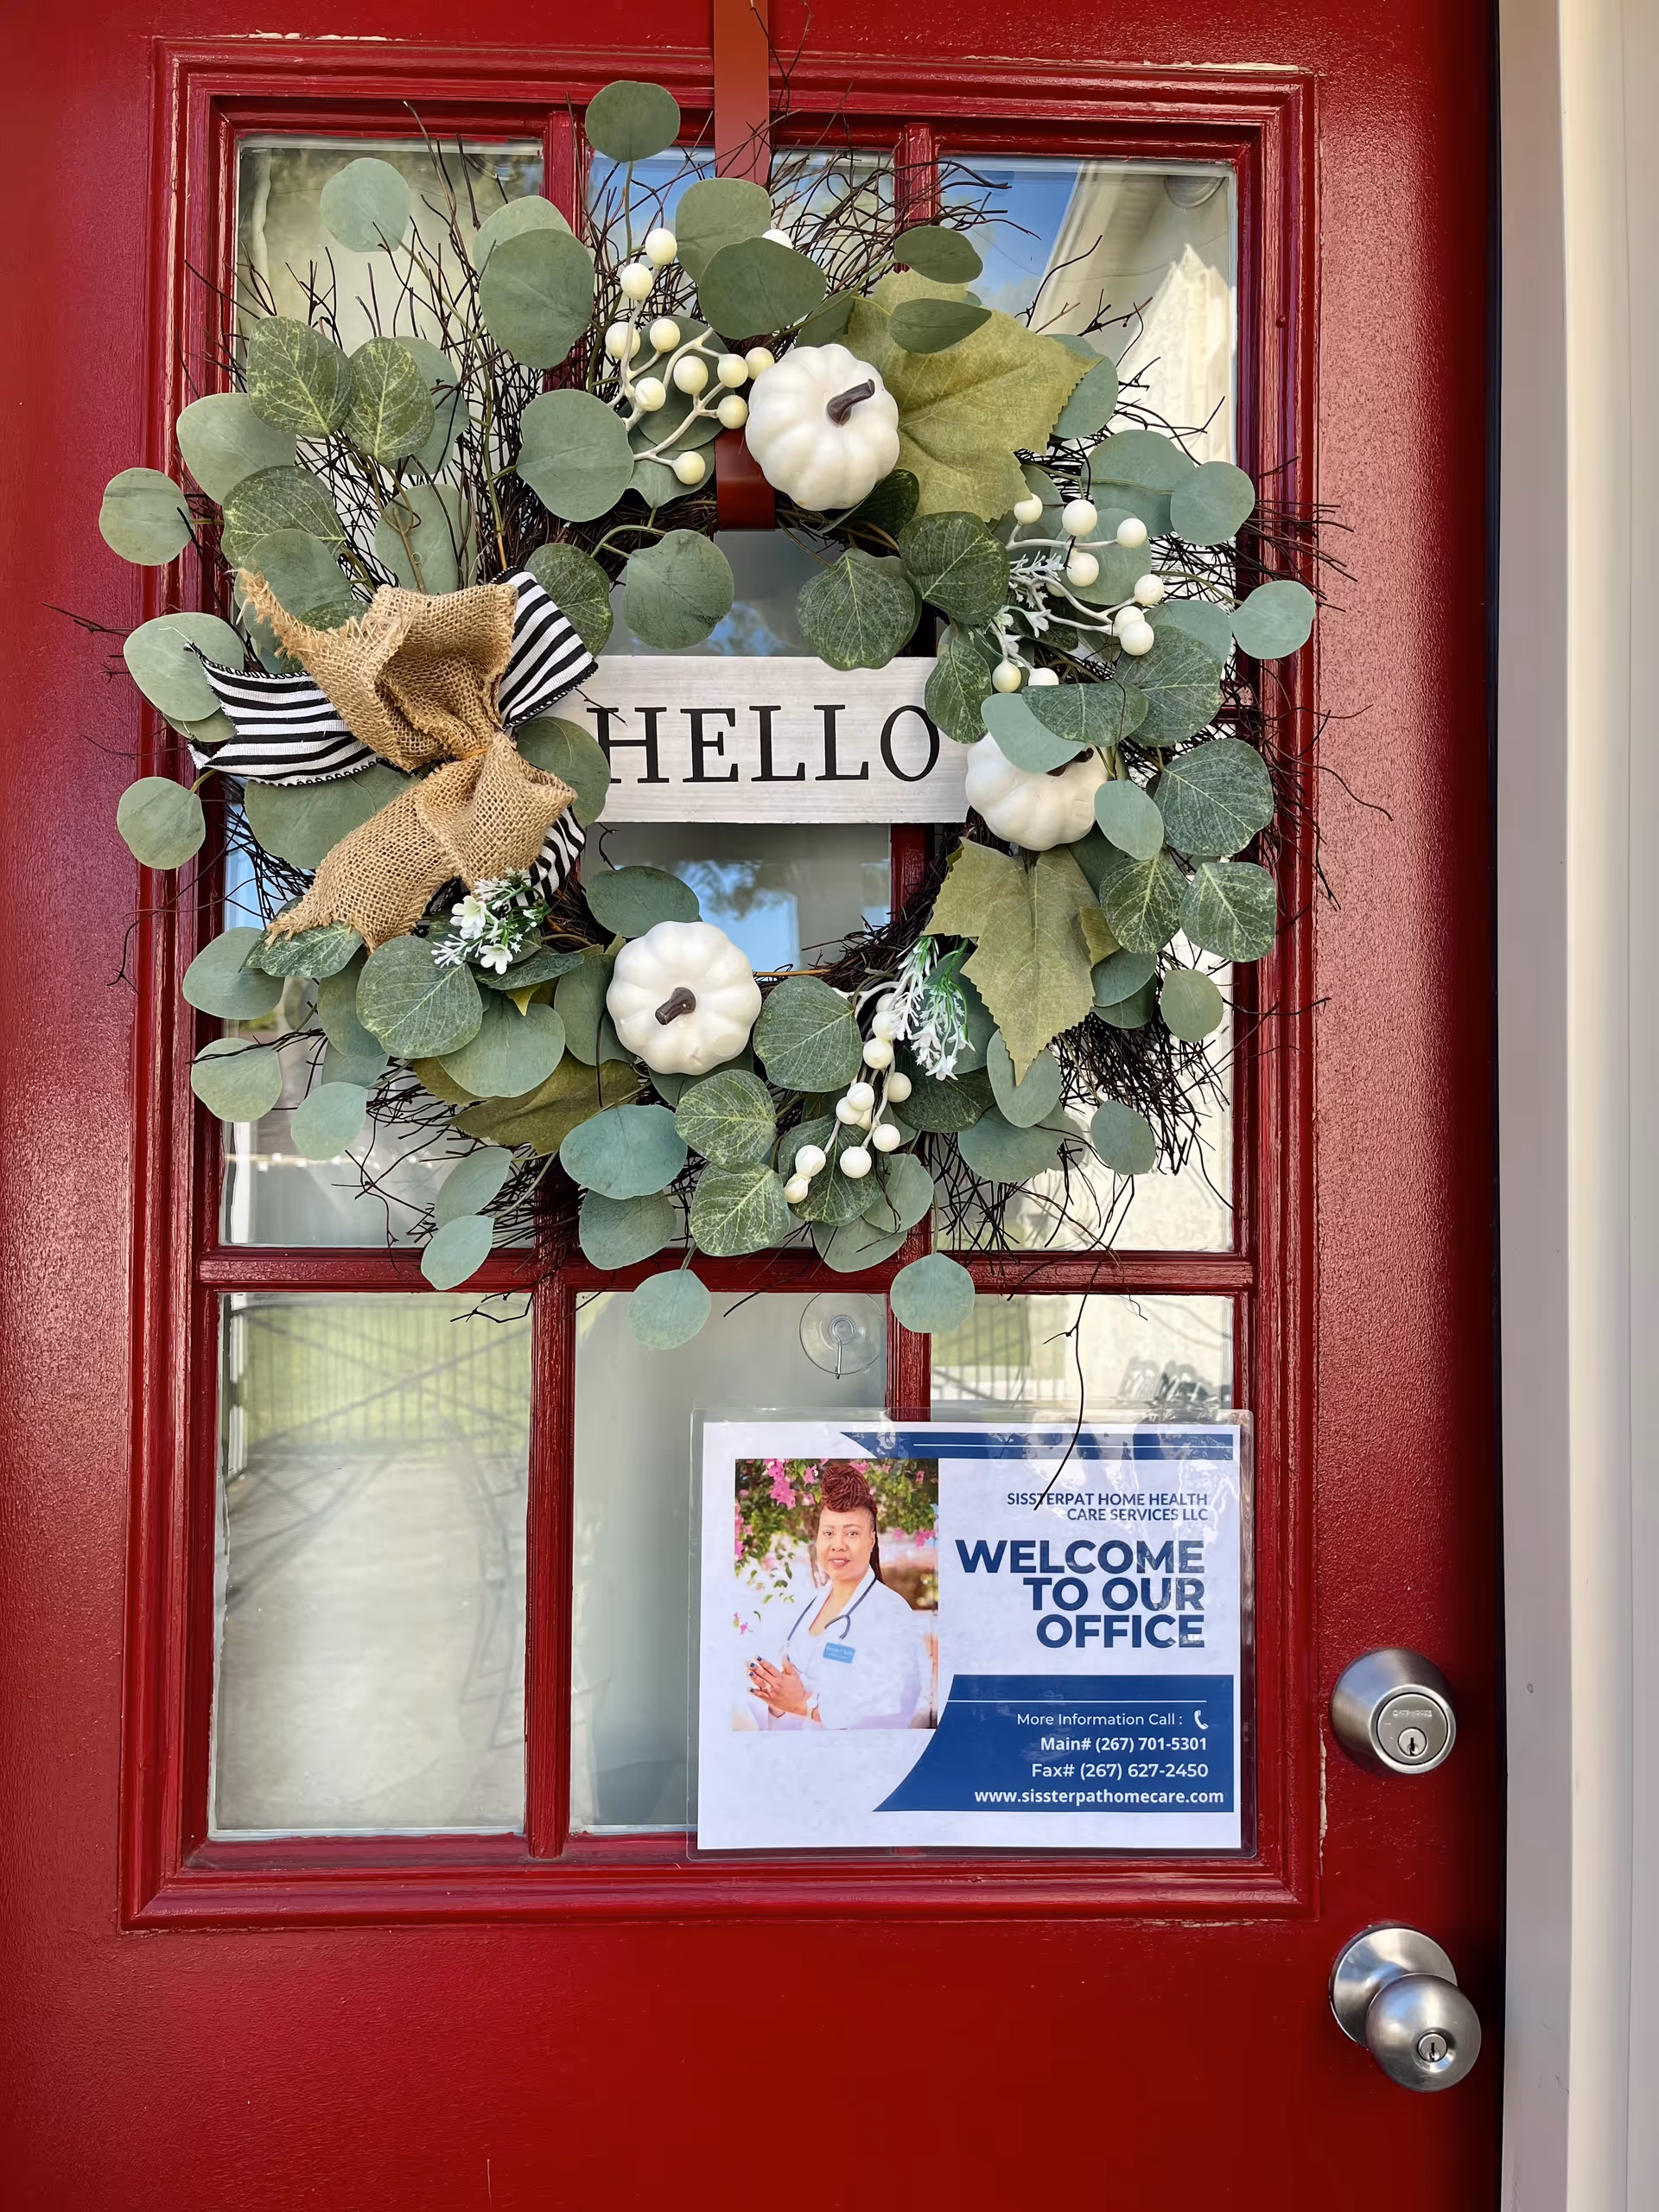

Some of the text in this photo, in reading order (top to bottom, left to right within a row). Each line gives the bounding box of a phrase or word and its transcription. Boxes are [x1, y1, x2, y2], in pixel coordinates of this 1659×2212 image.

[587, 705, 940, 783] HELLO
[1098, 1493, 1145, 1505] HOME
[1149, 1494, 1207, 1505] HEALTH
[1067, 1509, 1208, 1521] CARE SERVICES LLC
[955, 1540, 1205, 1573] WELCOME
[1023, 1577, 1205, 1611] TO OUR
[1037, 1614, 1205, 1648] OFFICE
[1017, 1713, 1054, 1726] More
[1058, 1713, 1144, 1726] Information
[1148, 1713, 1175, 1726] Call
[1040, 1737, 1206, 1753] Main# (267) 701-5301
[1032, 1764, 1209, 1780] Fax# (267) 627-2450
[975, 1789, 1224, 1806] www.sissterpathomecare.com
